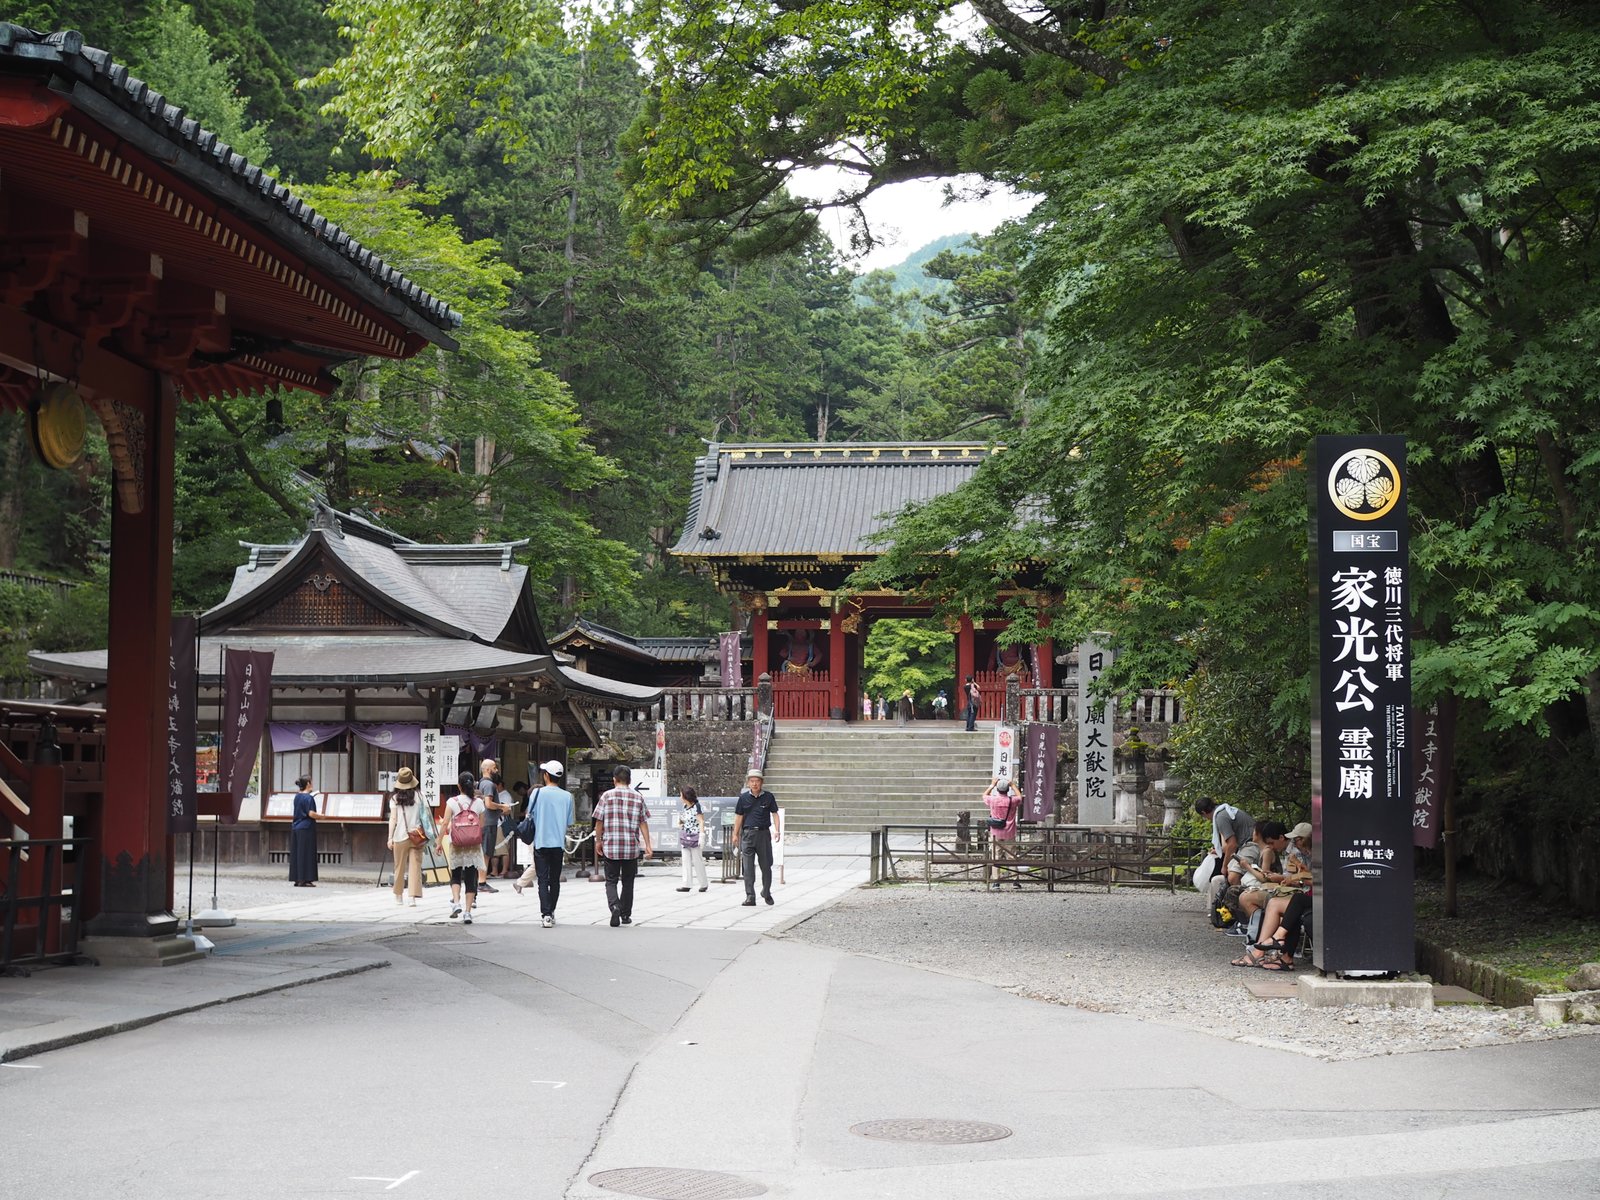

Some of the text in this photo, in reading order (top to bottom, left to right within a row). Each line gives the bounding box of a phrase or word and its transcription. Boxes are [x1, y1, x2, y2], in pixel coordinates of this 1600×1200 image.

[1350, 534, 1381, 548] 国宝
[1384, 566, 1404, 682] 徳川三代将軍
[1396, 704, 1405, 748] TAIYUIN
[423, 732, 436, 802] 拝観券受付所
[998, 751, 1008, 776] 日光
[1033, 732, 1046, 815] 日光山輪王寺大猷院
